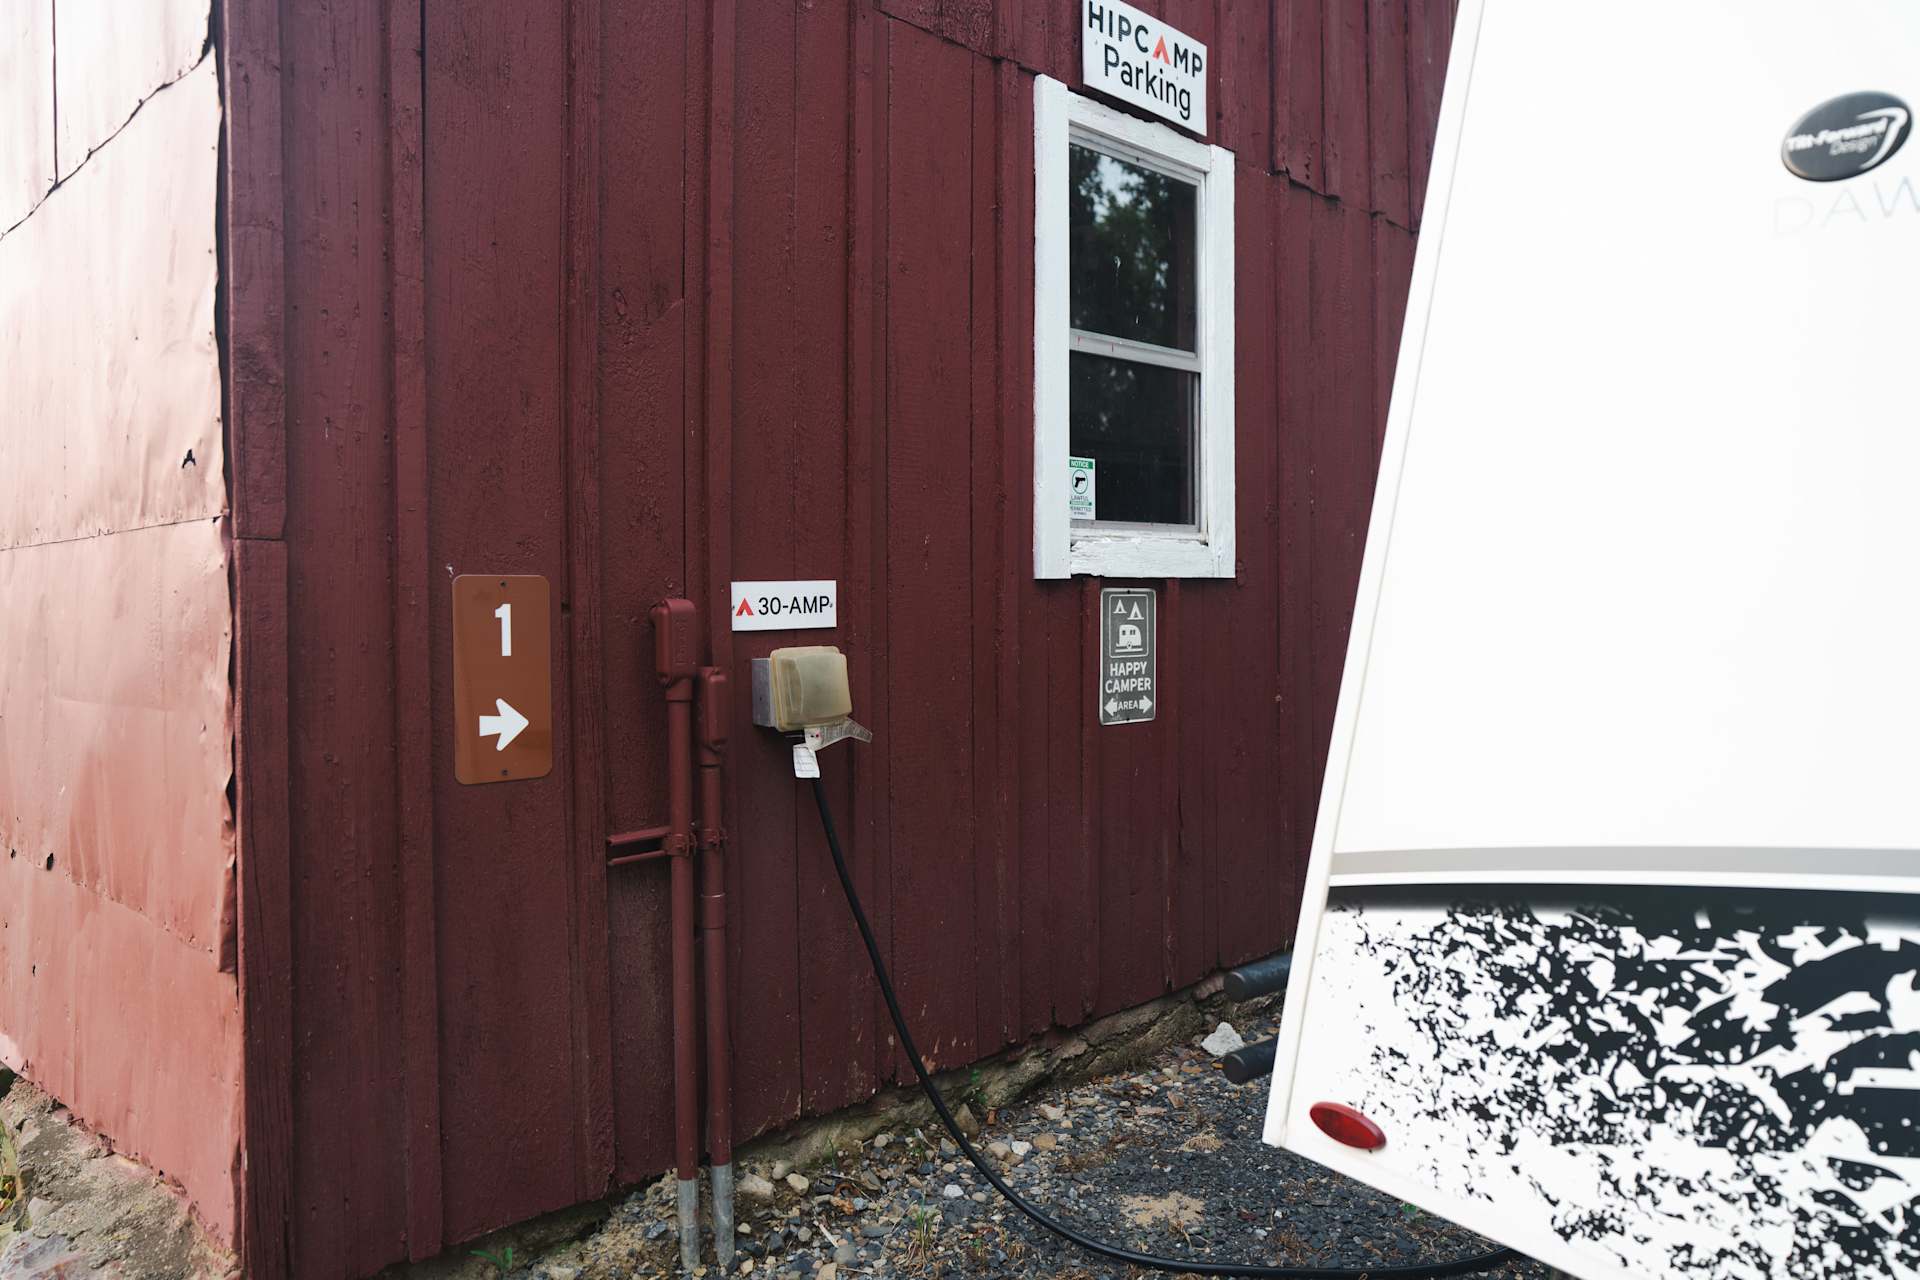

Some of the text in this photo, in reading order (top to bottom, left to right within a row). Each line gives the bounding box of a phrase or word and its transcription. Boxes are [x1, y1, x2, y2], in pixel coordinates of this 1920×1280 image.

[1088, 0, 1203, 78] HIPCAMP
[1104, 43, 1191, 121] Parking
[1071, 460, 1089, 468] NOTICE
[757, 595, 831, 616] 30-AMP
[494, 603, 512, 657] 1
[1109, 661, 1148, 677] HAPPY
[1105, 677, 1152, 694] CAMPER
[1118, 700, 1139, 711] AREA
